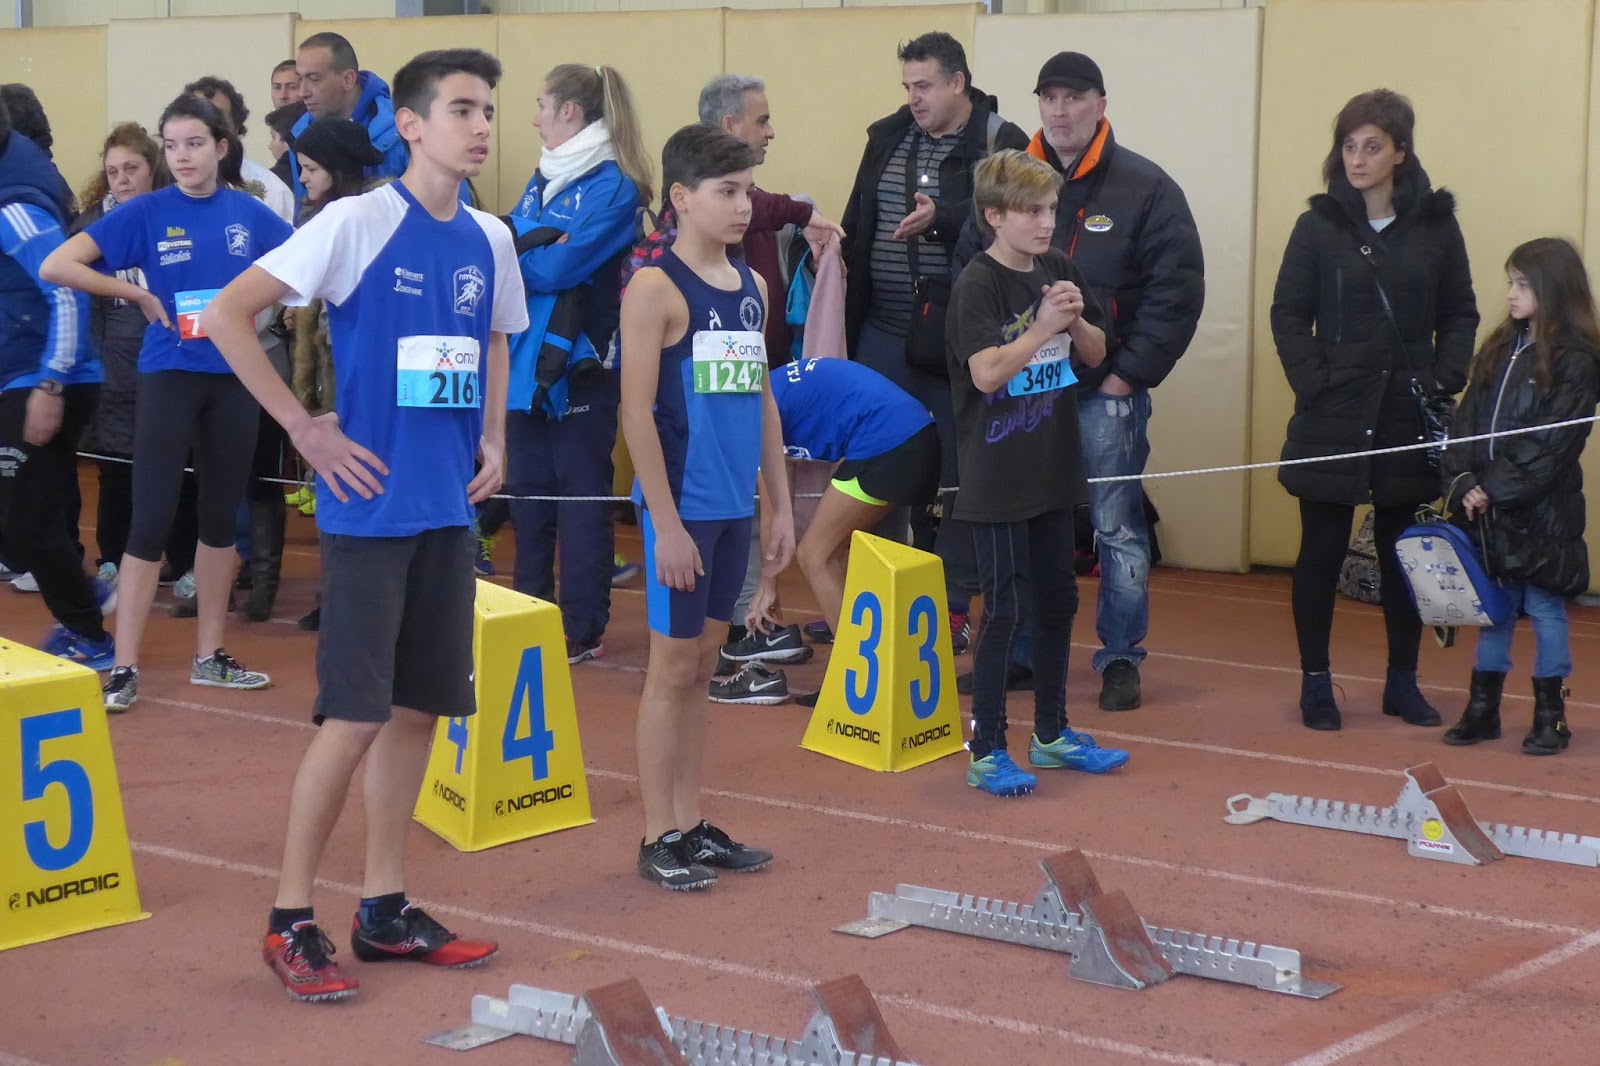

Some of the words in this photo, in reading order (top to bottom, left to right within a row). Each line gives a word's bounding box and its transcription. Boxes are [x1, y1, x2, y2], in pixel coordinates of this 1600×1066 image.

[186, 313, 206, 336] 7
[1021, 361, 1062, 392] 3499
[572, 404, 589, 413] asics
[844, 591, 883, 716] 3
[908, 595, 941, 720] 3
[502, 645, 554, 782] 4
[835, 721, 880, 746] NORDIC
[908, 723, 951, 749] NORDIC
[20, 707, 93, 870] 5
[438, 785, 466, 812] NORDIC
[507, 783, 573, 813] NORDIC
[27, 872, 120, 908] NORDIC
